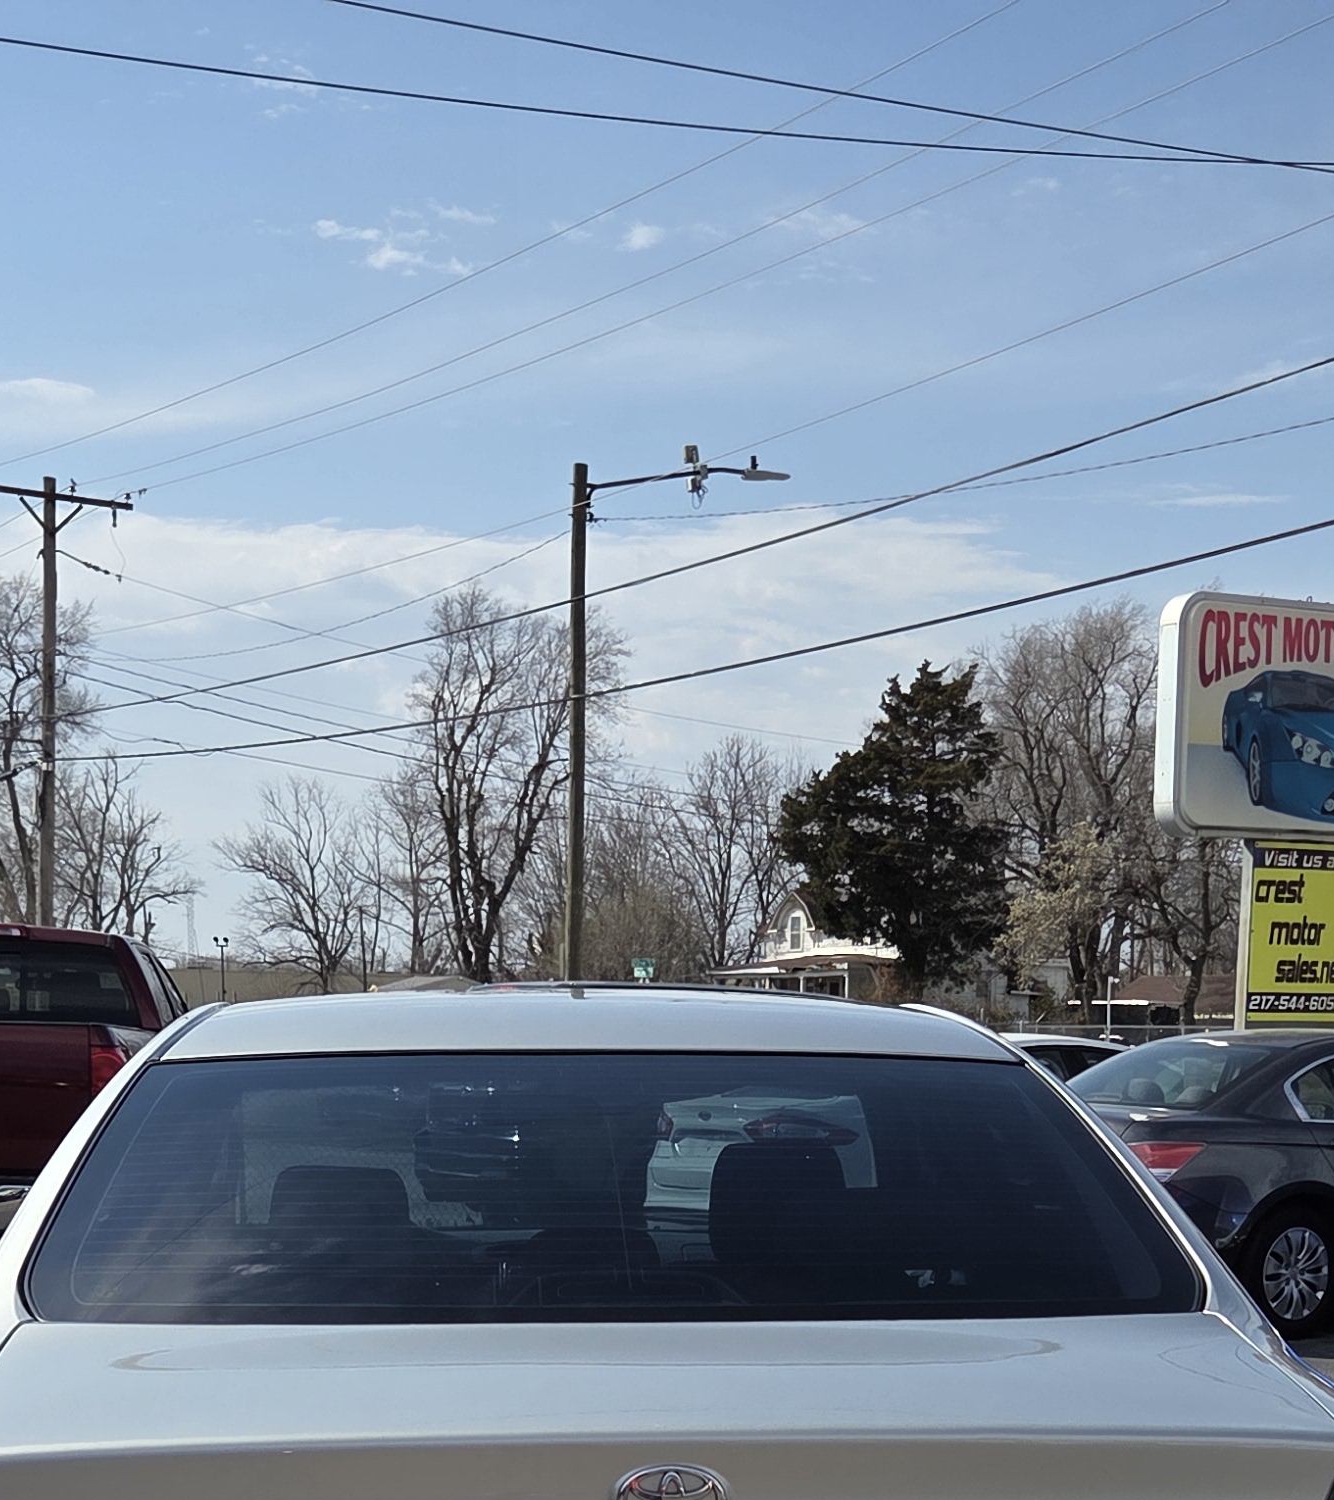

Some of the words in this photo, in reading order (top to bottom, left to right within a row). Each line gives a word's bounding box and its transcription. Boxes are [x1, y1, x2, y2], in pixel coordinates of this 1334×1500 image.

[1198, 608, 1278, 688] CREST
[1265, 850, 1299, 867] Visit
[1302, 855, 1323, 868] us
[1255, 873, 1305, 904] crest
[1269, 915, 1326, 946] motor
